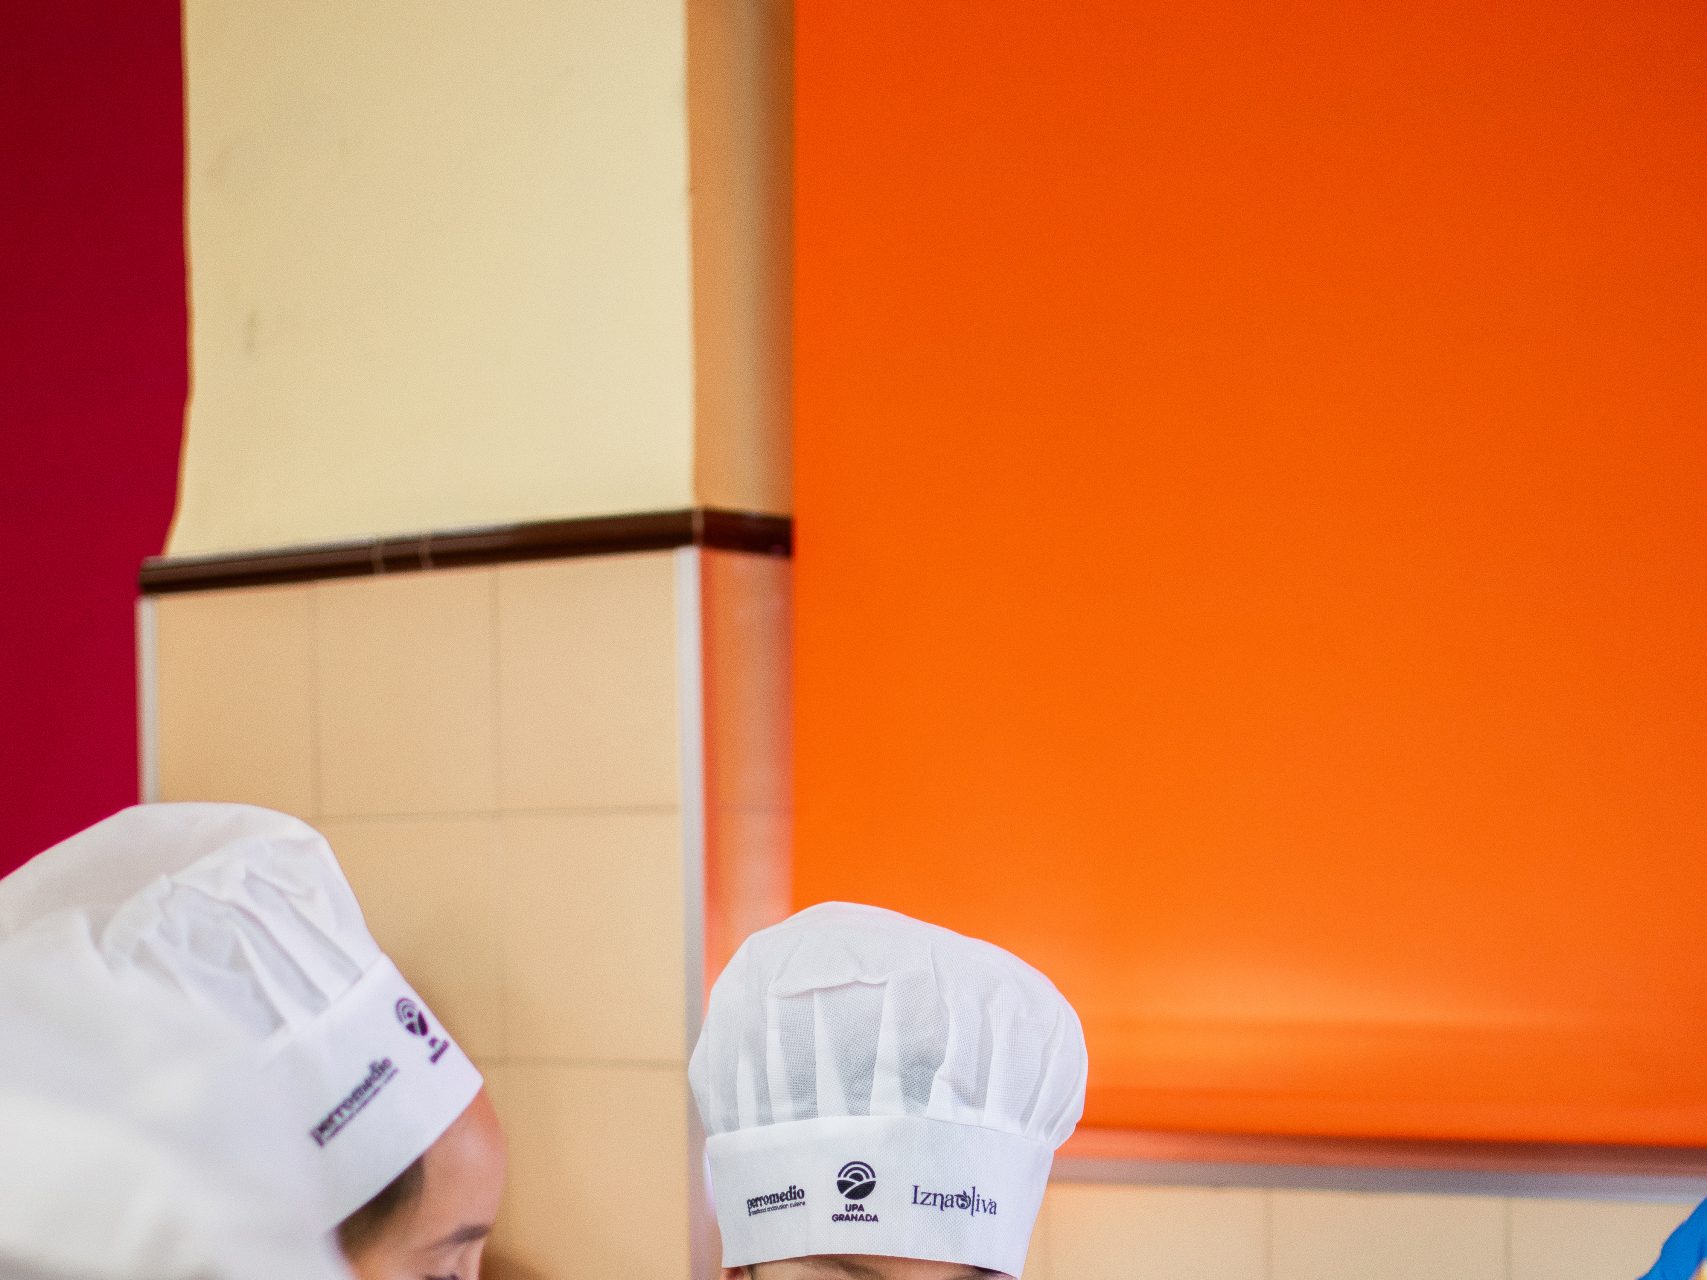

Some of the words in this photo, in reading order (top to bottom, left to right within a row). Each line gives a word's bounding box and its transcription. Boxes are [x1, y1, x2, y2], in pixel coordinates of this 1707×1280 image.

[746, 1184, 806, 1217] perromedio
[844, 1203, 865, 1213] UPA
[831, 1213, 880, 1223] GRANADA
